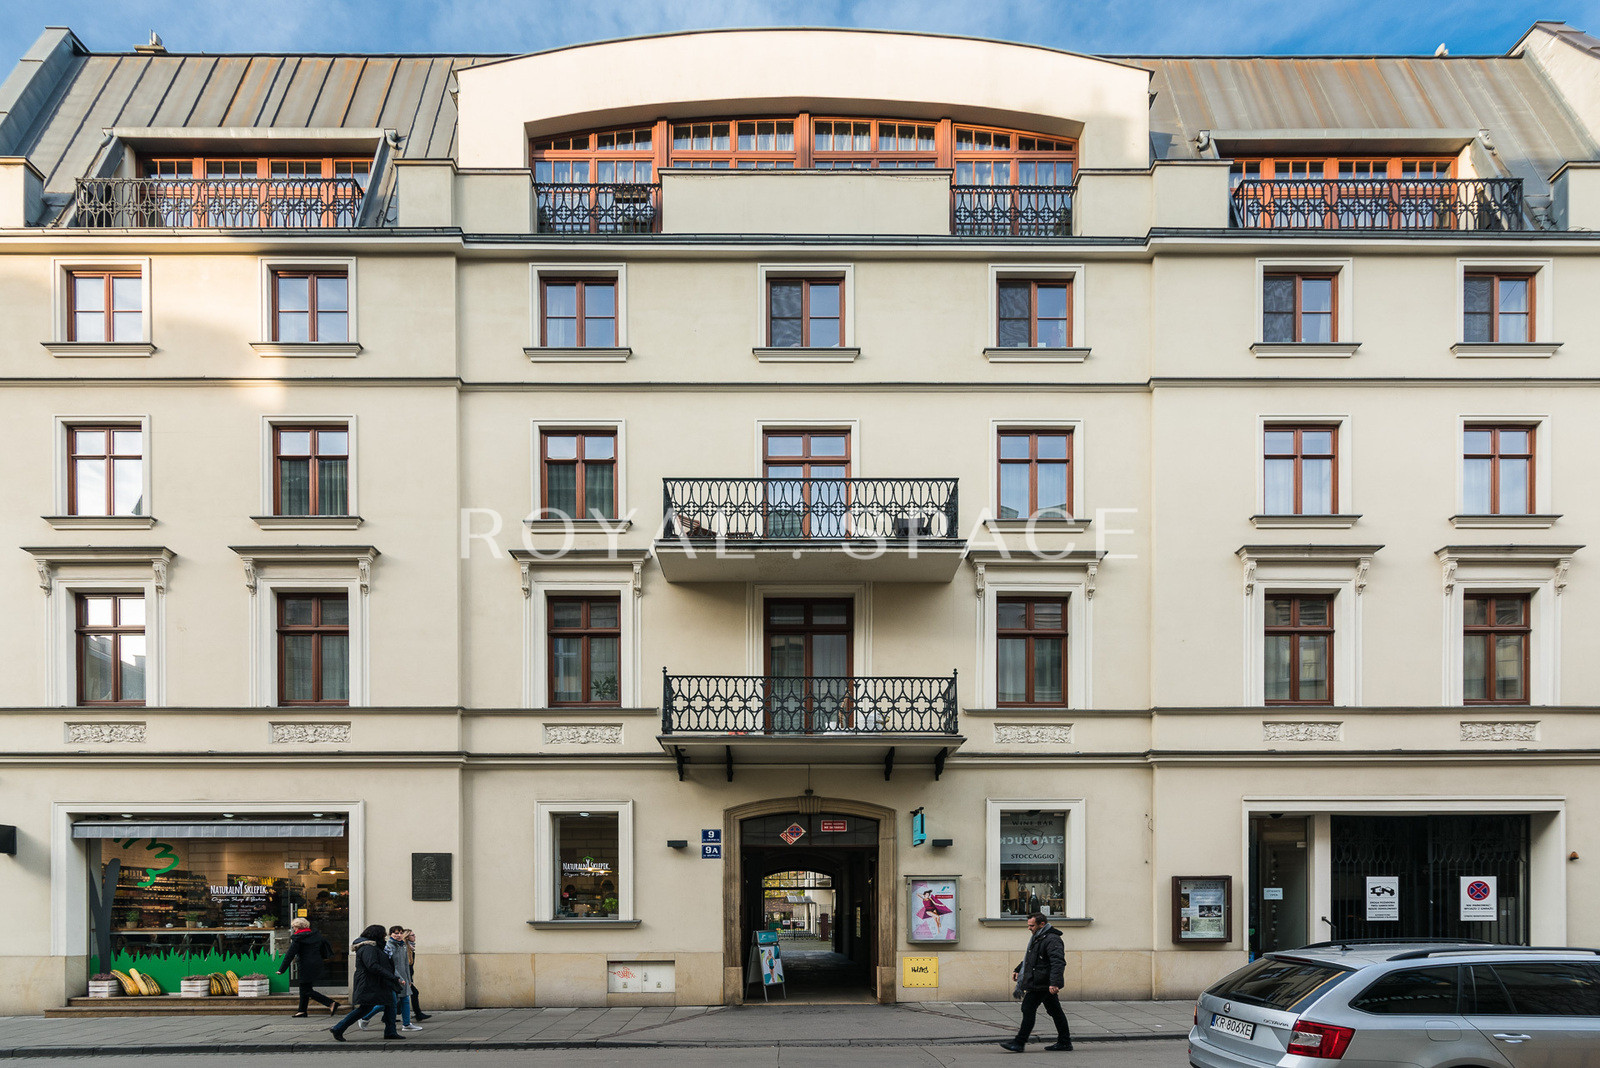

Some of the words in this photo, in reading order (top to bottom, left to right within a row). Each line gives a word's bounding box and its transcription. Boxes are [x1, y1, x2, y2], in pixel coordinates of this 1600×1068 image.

[708, 830, 715, 838] 9
[705, 846, 718, 854] 9A
[1215, 1016, 1226, 1029] KR
[1226, 1019, 1252, 1036] 806XE
